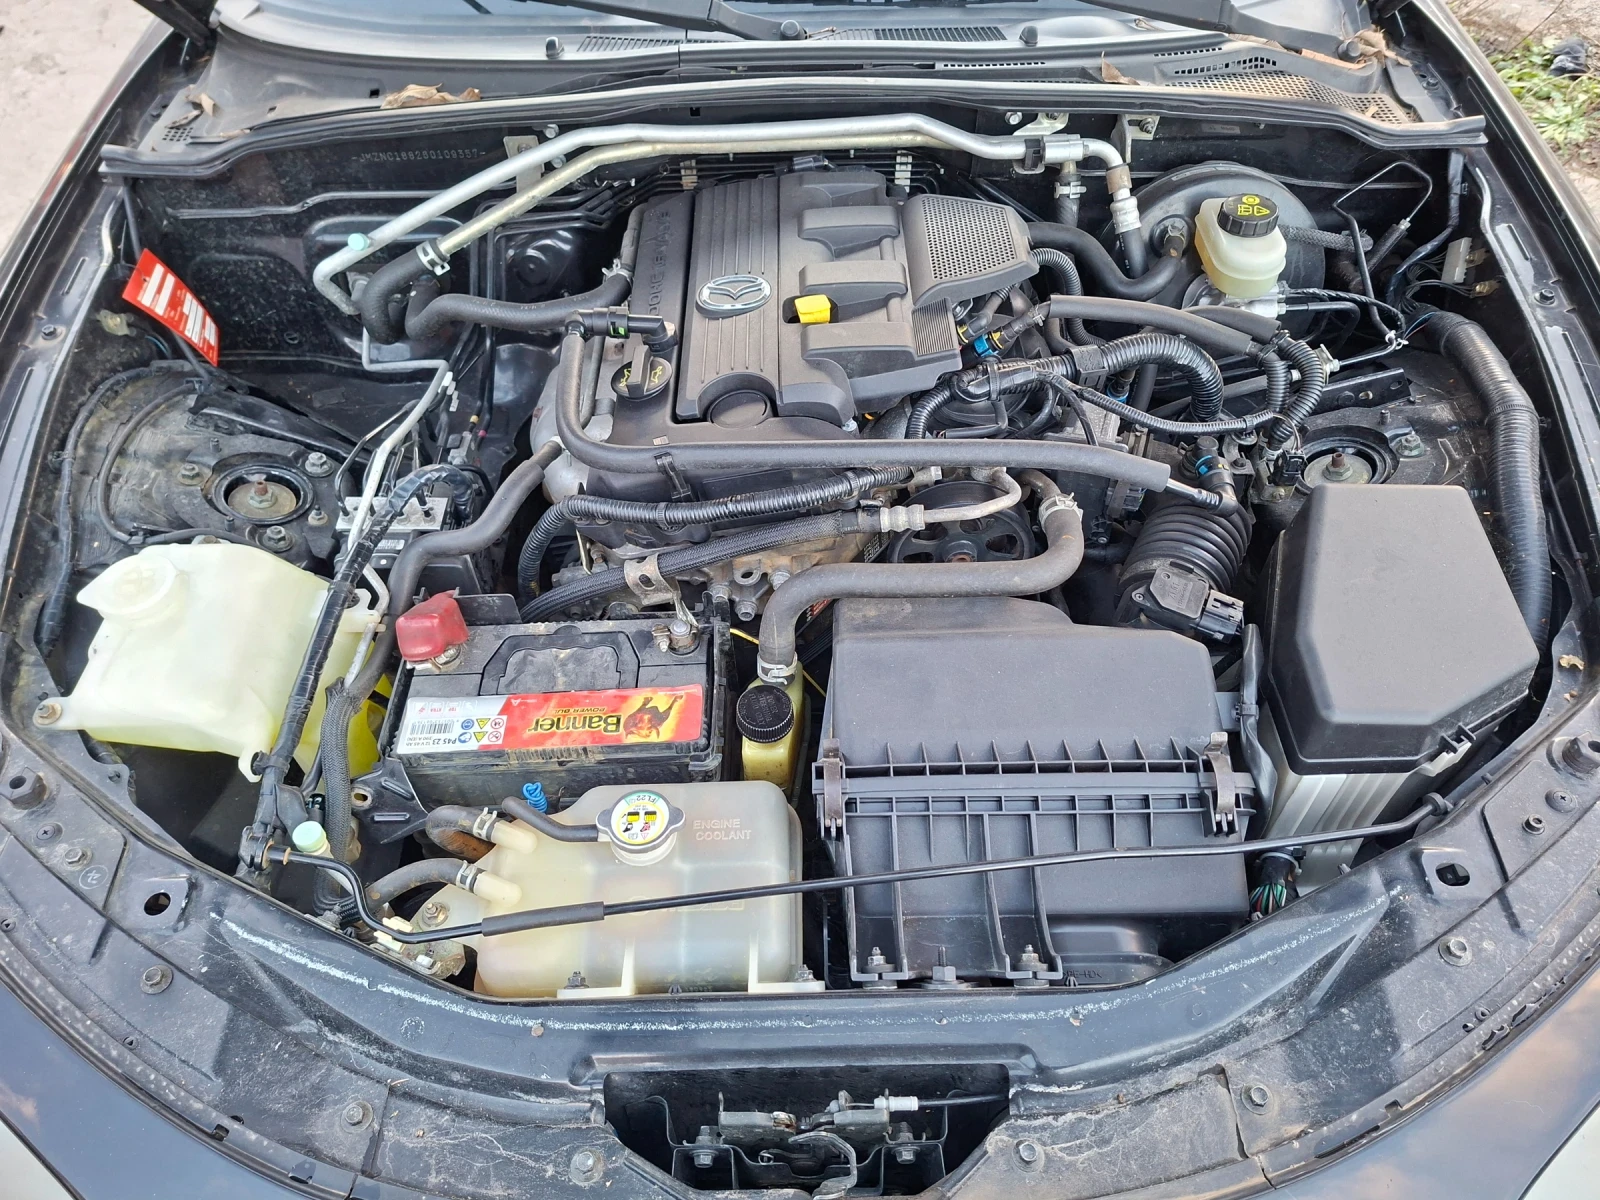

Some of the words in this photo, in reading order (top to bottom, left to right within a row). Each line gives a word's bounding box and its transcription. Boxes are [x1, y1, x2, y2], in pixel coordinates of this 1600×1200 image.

[528, 714, 622, 734] Banner
[636, 794, 656, 803] FL22
[693, 818, 741, 830] ENGINE
[695, 829, 752, 841] COOLANT
